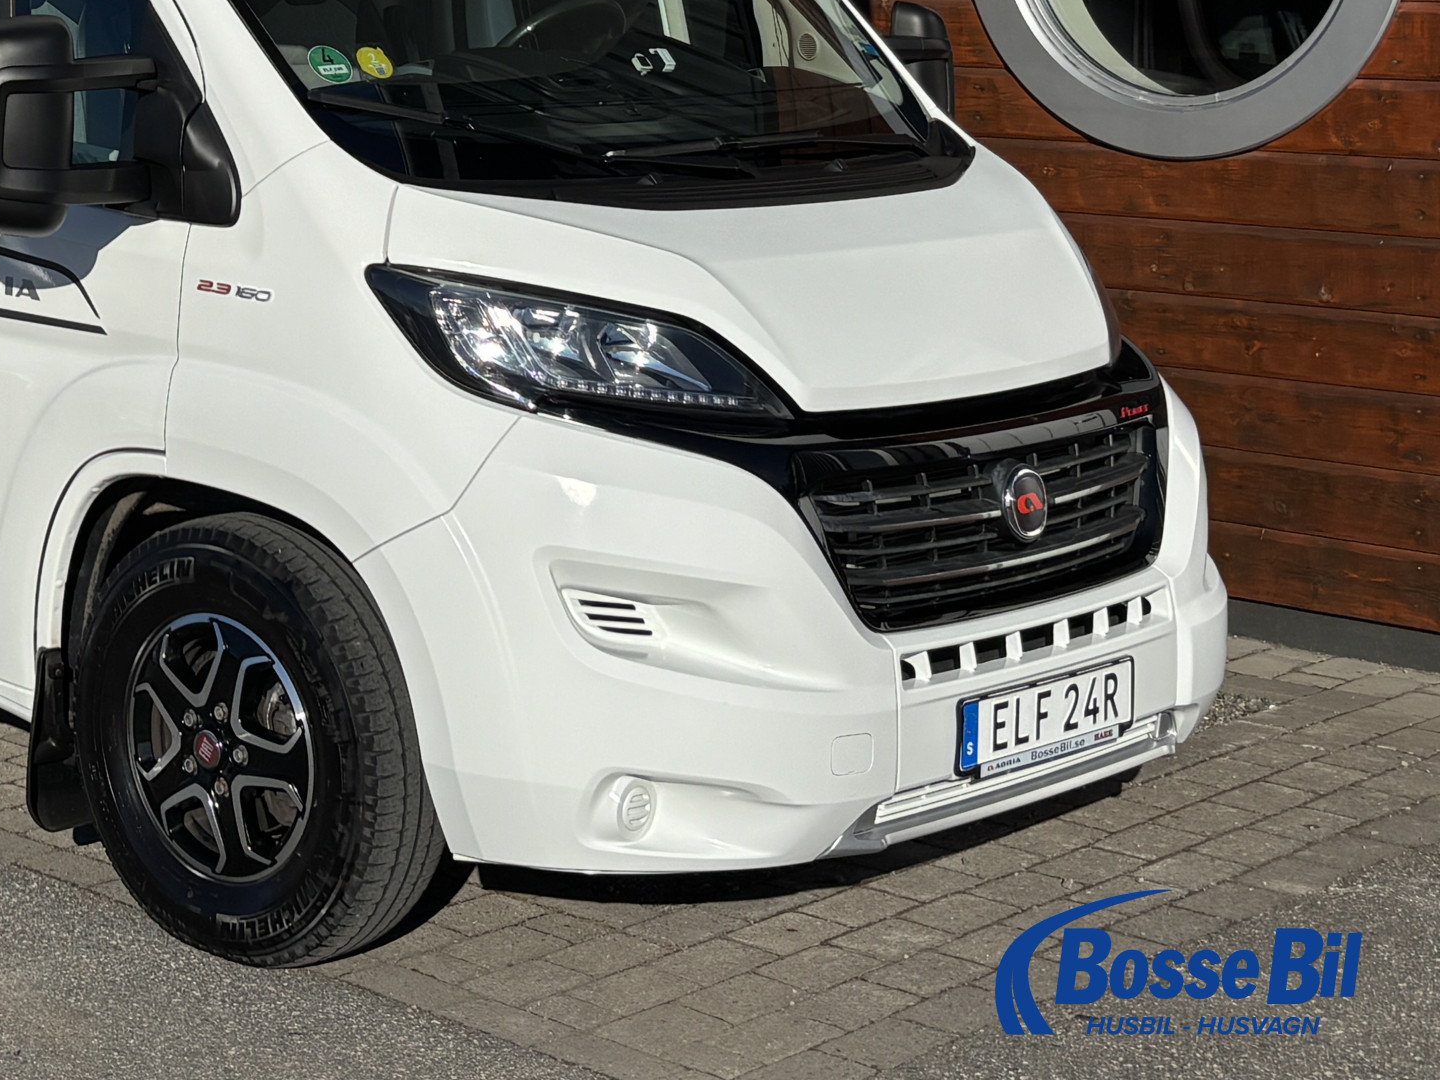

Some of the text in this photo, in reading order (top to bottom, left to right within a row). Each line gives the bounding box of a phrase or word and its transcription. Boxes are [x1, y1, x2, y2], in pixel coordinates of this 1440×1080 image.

[992, 672, 1119, 752] ELF 24R
[198, 735, 215, 764] FIAT
[966, 741, 974, 756] S
[995, 757, 1021, 770] ADRIA
